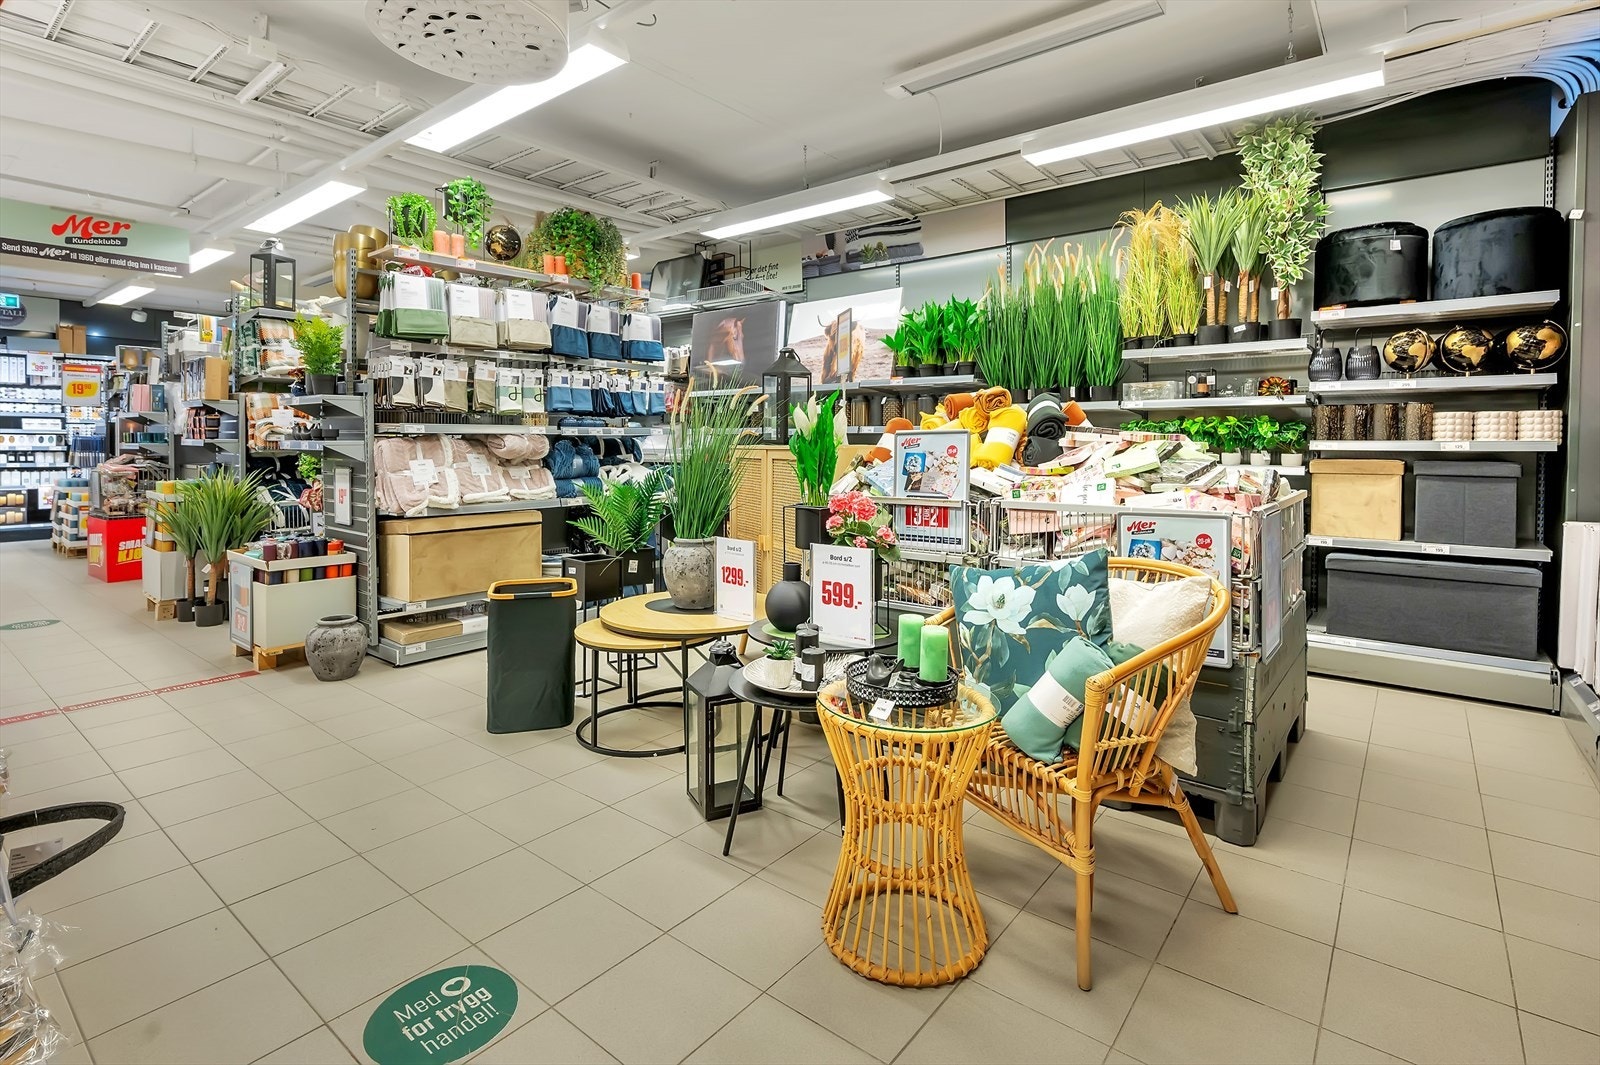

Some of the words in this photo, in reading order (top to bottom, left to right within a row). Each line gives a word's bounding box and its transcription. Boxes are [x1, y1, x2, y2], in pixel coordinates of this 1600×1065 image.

[51, 214, 131, 239] Mer
[72, 236, 122, 246] Kundeklubb
[1, 242, 21, 253] Send
[22, 244, 38, 255] SMS
[39, 246, 70, 258] Mer
[78, 252, 94, 262] 1960
[95, 255, 109, 264] eller
[110, 258, 126, 267] meld
[127, 260, 139, 269] deg
[140, 261, 150, 269] inn
[154, 264, 177, 273] kassen!
[901, 437, 921, 448] Mer
[913, 505, 922, 525] 3
[930, 505, 938, 526] 2
[1127, 520, 1156, 532] Mer
[829, 554, 843, 562] Bord
[843, 555, 853, 563] s/2
[821, 580, 863, 610] 599.-
[393, 991, 442, 1024] Med
[401, 1017, 436, 1042] for
[435, 987, 493, 1022] trygg
[420, 1002, 500, 1056] handel!
